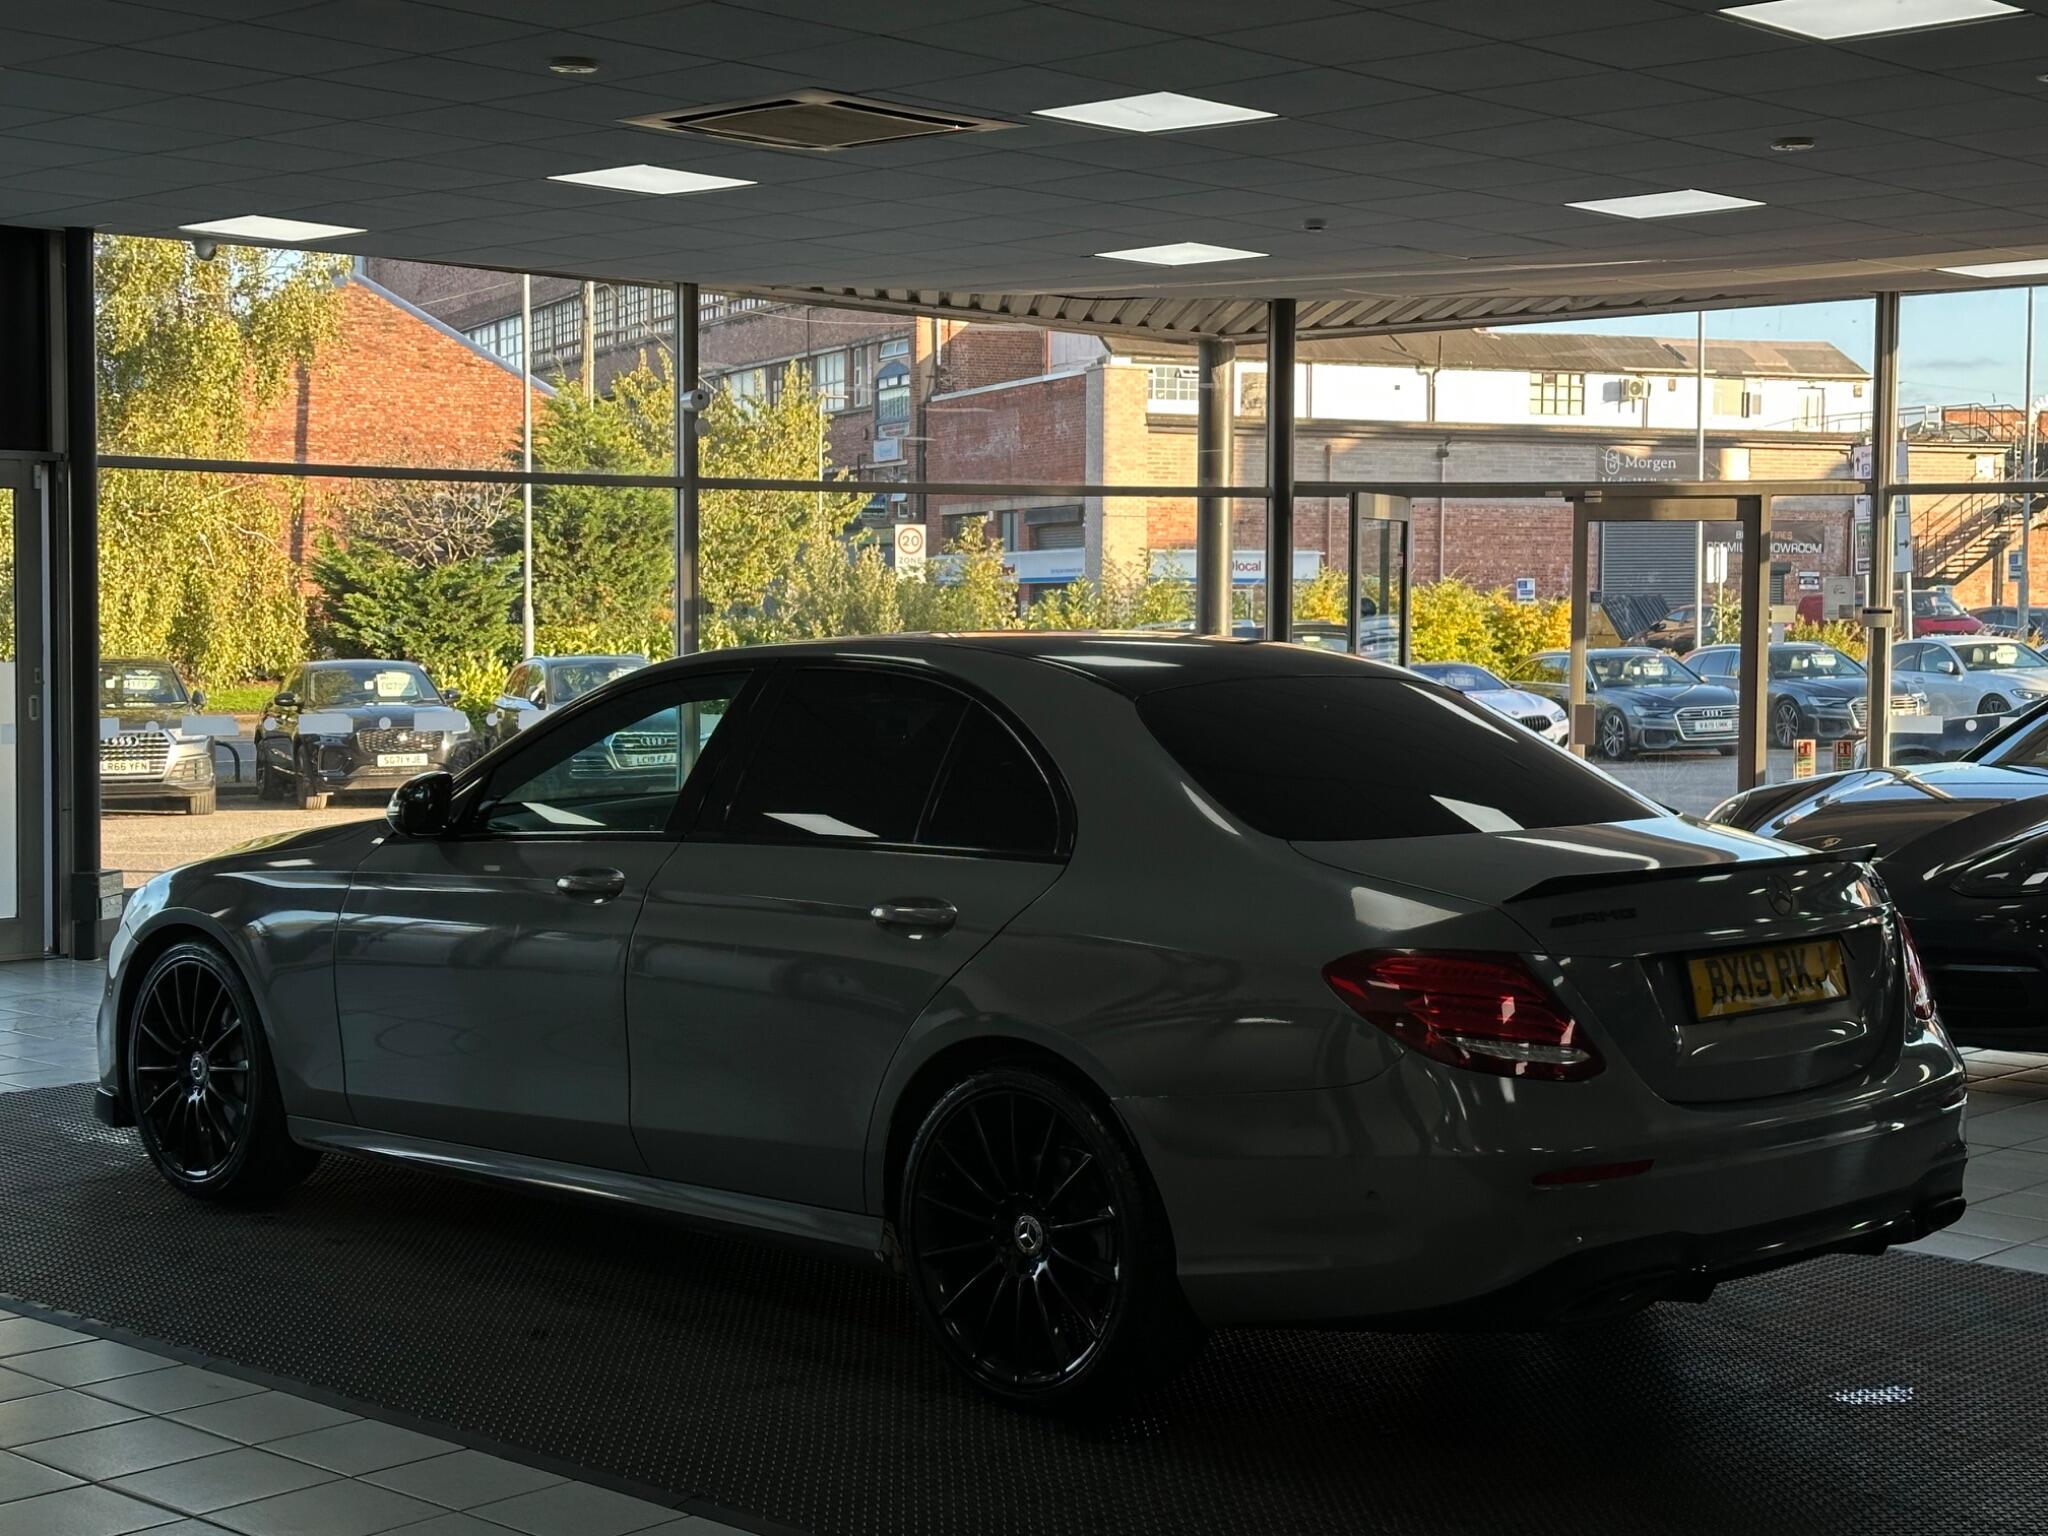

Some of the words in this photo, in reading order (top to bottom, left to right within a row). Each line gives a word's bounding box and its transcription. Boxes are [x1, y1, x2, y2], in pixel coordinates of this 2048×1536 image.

[1625, 456, 1677, 471] Morgen
[902, 536, 920, 547] 20
[898, 556, 923, 566] ZONE
[101, 761, 127, 772] LR66
[129, 760, 148, 771] YFN
